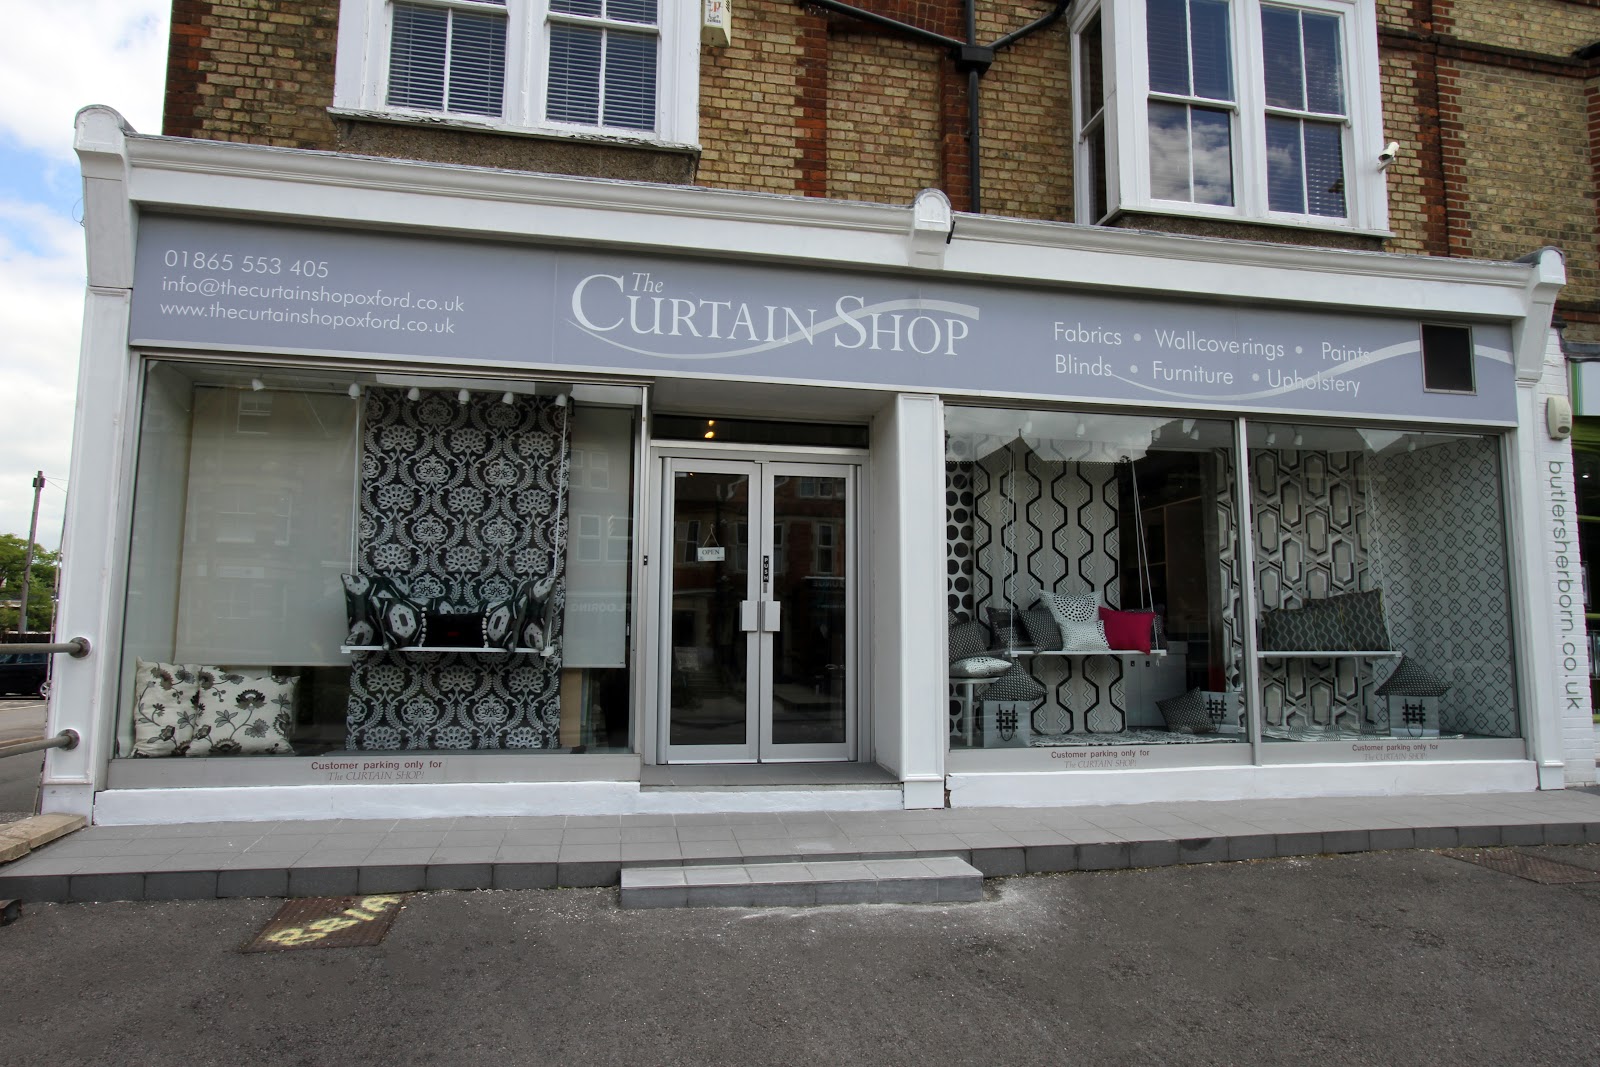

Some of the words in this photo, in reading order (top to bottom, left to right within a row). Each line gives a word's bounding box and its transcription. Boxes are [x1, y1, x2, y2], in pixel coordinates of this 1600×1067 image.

[164, 250, 233, 271] 01865
[241, 255, 281, 275] 553
[289, 260, 329, 278] 405
[162, 276, 465, 313] info@thecurtainshopoxford.co.uk
[632, 272, 664, 294] The
[159, 302, 455, 334] www.thecurtainshopoxford.co.uk
[571, 273, 818, 346] CURTAIN
[833, 295, 969, 356] SHOP
[1053, 322, 1122, 345] Fabrics
[1154, 328, 1285, 361] Wallcoverings
[1321, 342, 1371, 363] Paints
[1055, 354, 1113, 377] Blinds
[1152, 361, 1234, 385] Furniture
[1267, 369, 1361, 397] Upholstery
[1549, 461, 1583, 710] butlersherborn.co.uk
[1051, 751, 1087, 759] Customer
[1090, 749, 1118, 758] parking
[1121, 749, 1136, 757] only
[1352, 744, 1384, 752] Customer
[1386, 743, 1411, 752] parking
[1413, 743, 1427, 751] only
[311, 761, 359, 770] Customer
[363, 761, 400, 770] parking
[404, 760, 424, 769] only
[429, 760, 442, 768] for
[328, 771, 343, 781] The
[345, 771, 392, 781] CURTAIN
[1077, 759, 1112, 768] CURTAIN
